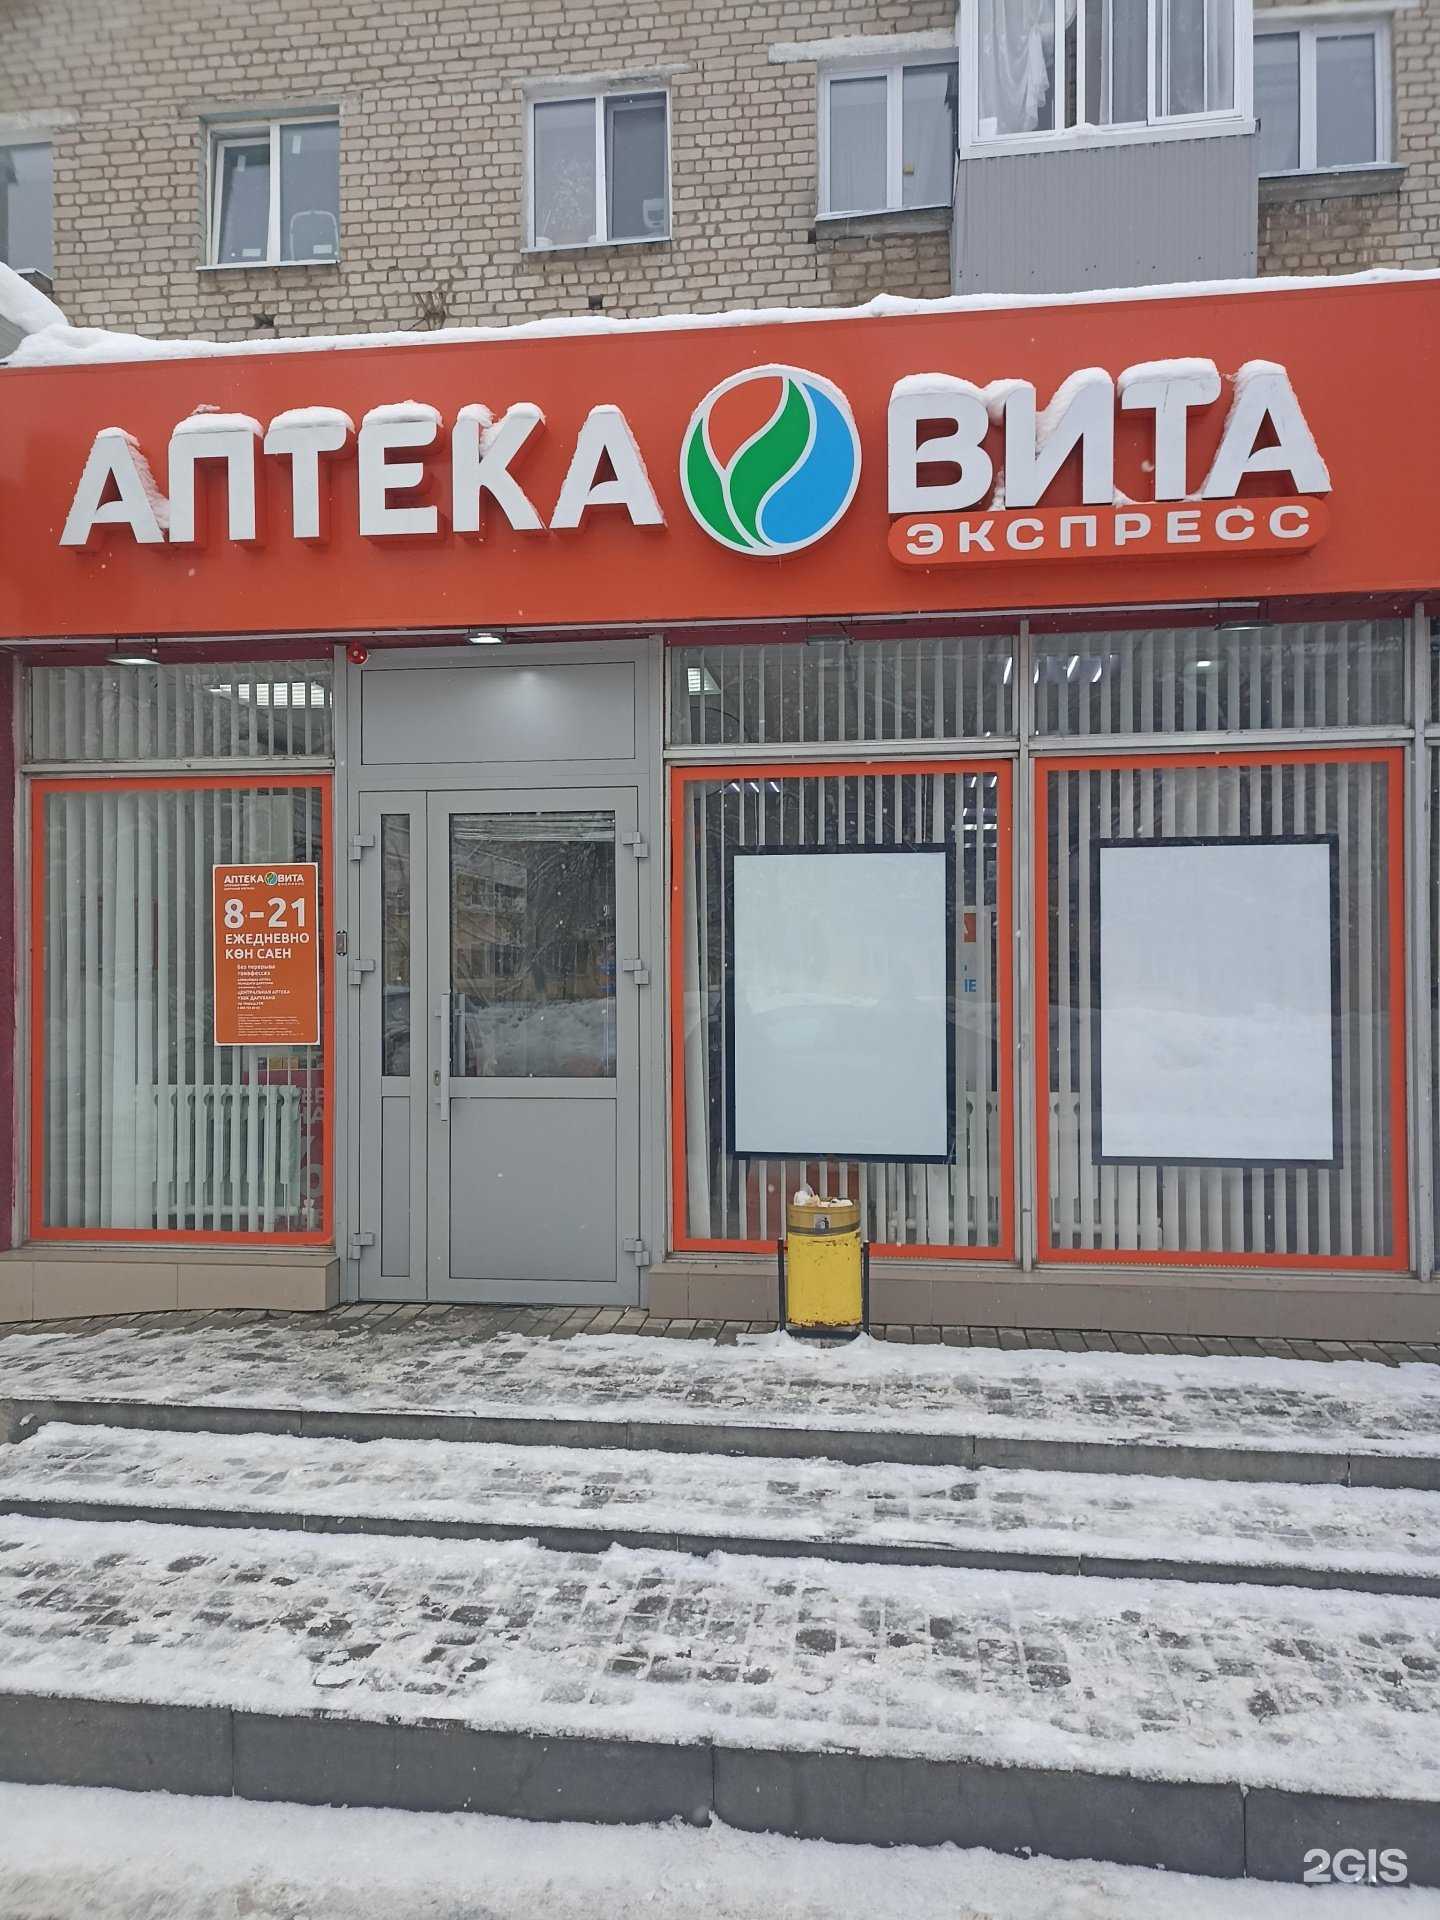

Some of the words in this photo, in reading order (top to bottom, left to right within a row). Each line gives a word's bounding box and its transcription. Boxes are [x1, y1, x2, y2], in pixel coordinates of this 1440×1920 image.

[60, 402, 666, 546] АПТЕКА
[888, 359, 1333, 515] ВИТА
[905, 504, 1312, 556] ЭКСПРЕСС
[224, 874, 265, 884] АПТЕКА
[278, 873, 304, 883] ВИТА
[225, 932, 310, 947] ЕЖЕДНЕВНО
[225, 948, 253, 960] КӨН
[257, 947, 291, 959] САЕН
